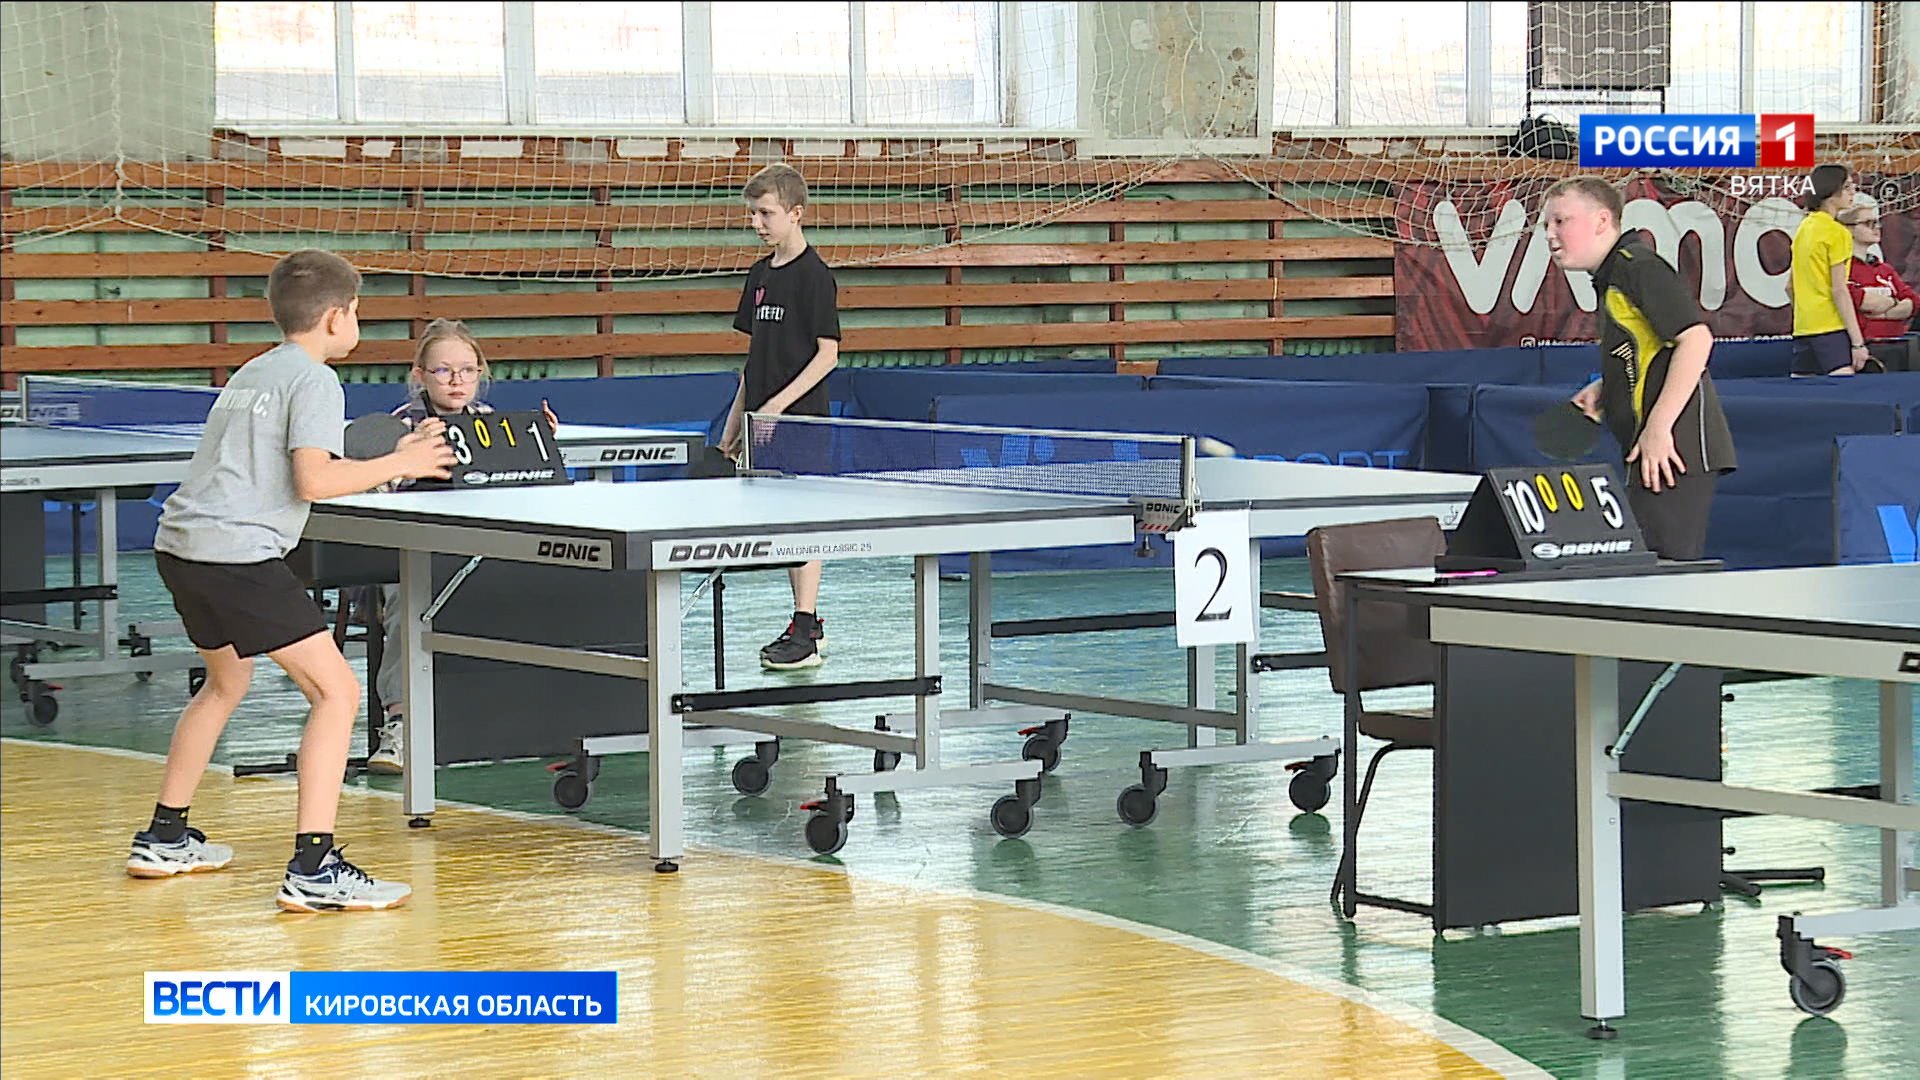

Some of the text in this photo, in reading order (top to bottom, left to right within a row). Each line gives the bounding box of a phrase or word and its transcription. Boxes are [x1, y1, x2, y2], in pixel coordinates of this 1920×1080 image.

[448, 418, 549, 465] 3 0 1 1
[600, 447, 676, 462] DONIC
[490, 469, 555, 481] DONIC
[1503, 472, 1624, 534] 10 0 0 5
[537, 541, 600, 562] DONIC
[669, 541, 772, 562] DONIC
[823, 544, 858, 554] CLASSIC
[1561, 540, 1633, 555] DONIC
[1194, 547, 1232, 622] 2
